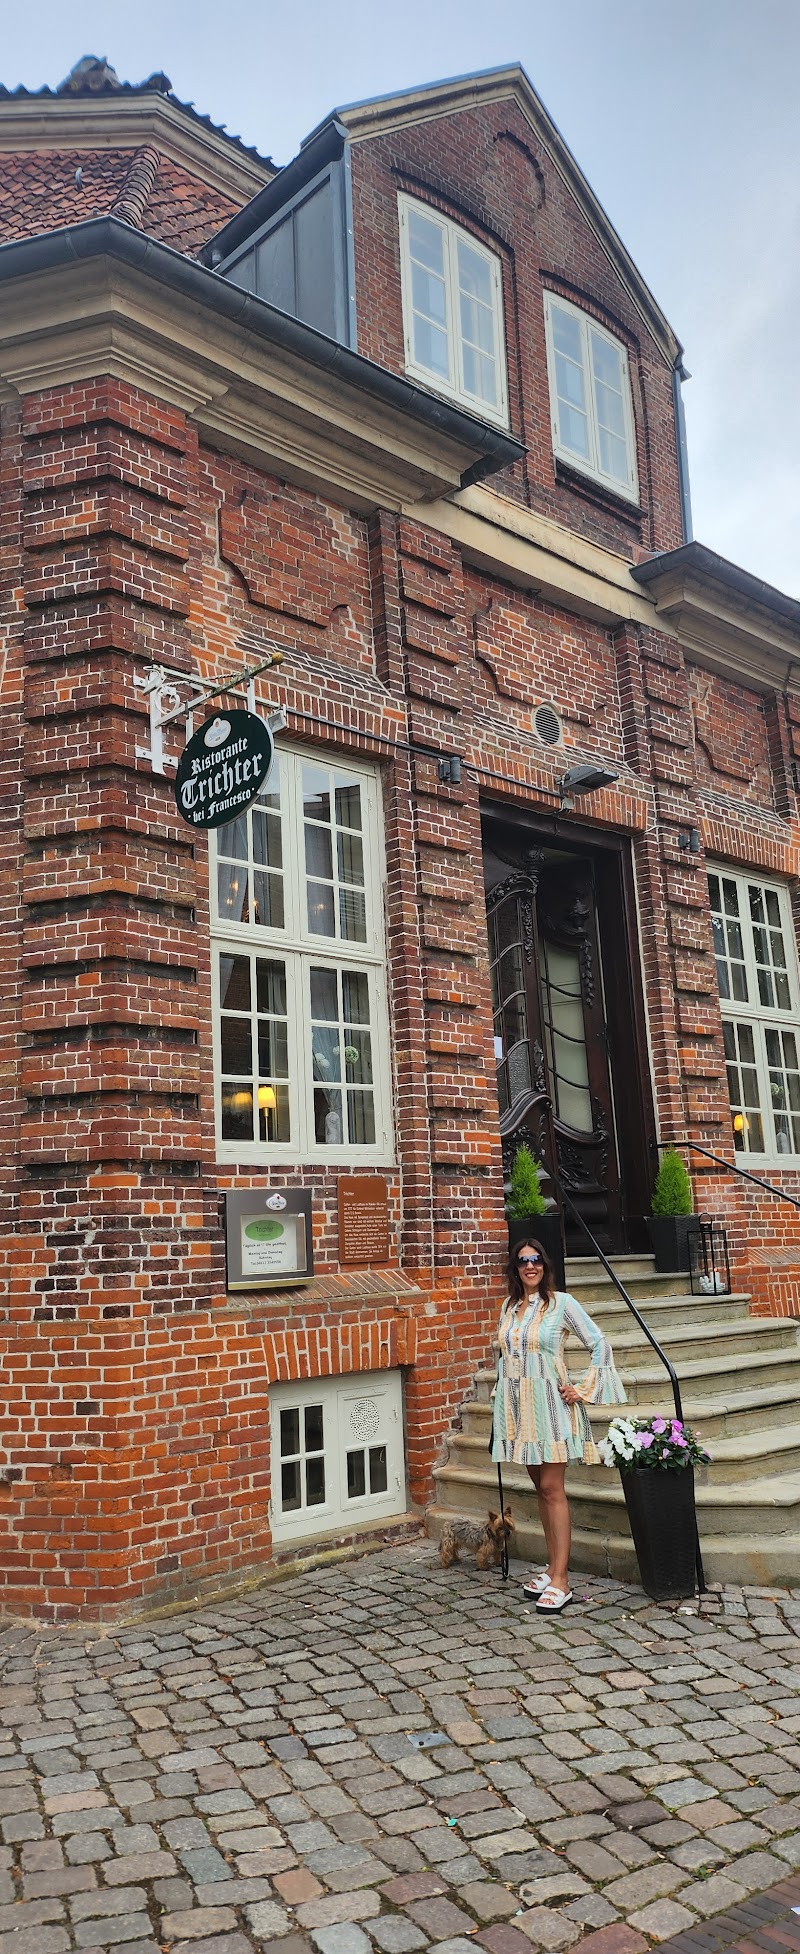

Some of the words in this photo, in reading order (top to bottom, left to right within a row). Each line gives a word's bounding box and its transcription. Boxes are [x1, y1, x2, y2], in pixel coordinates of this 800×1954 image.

[191, 737, 249, 776] Ristorante
[181, 753, 263, 809] Trichter
[192, 807, 205, 823] bei
[207, 788, 251, 819] Francesco
